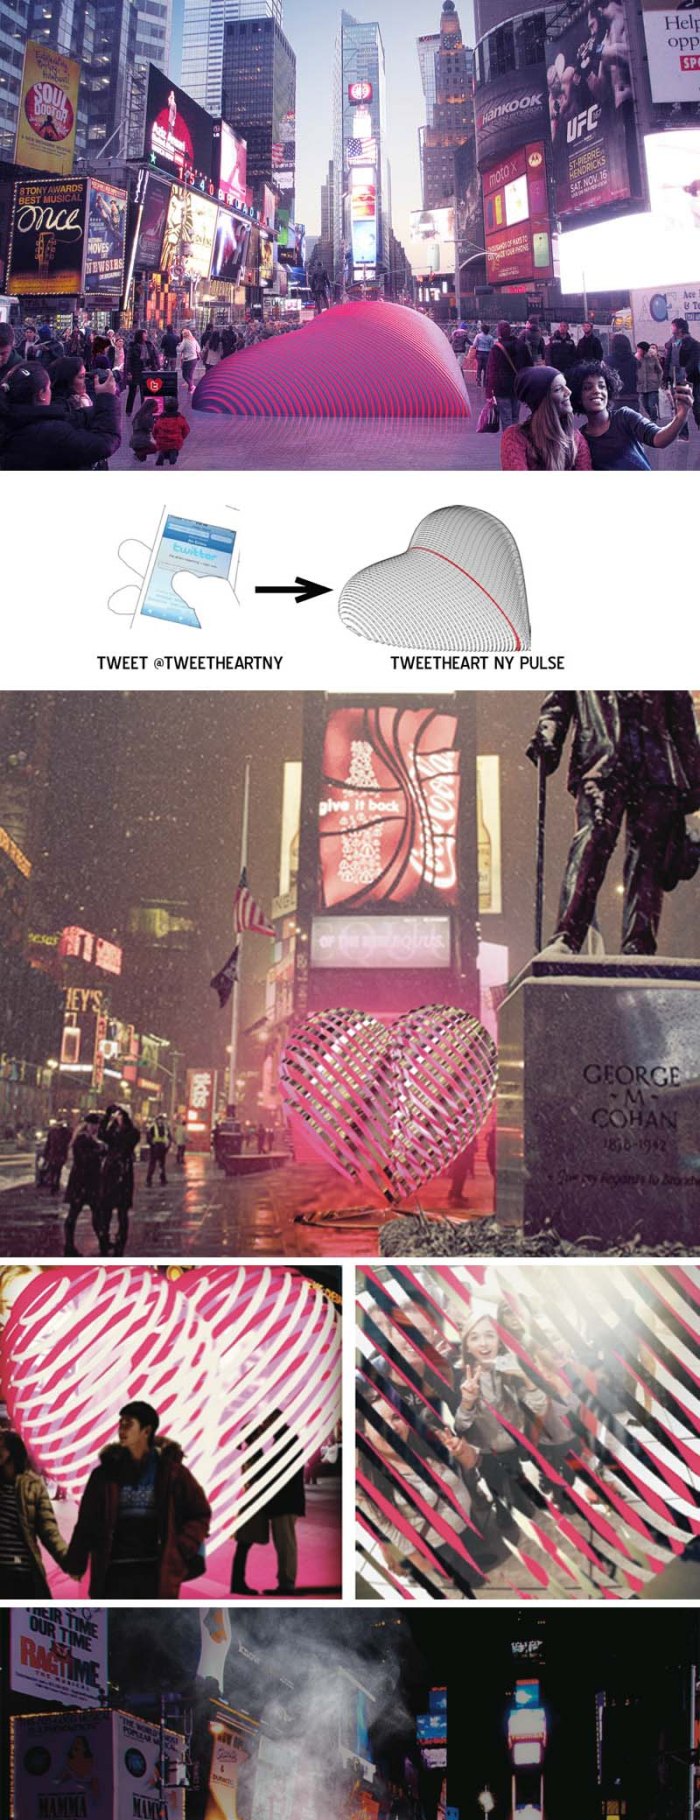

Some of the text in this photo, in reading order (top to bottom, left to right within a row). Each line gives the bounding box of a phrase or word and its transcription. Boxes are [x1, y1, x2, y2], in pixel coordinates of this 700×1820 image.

[33, 82, 68, 110] SOUL
[34, 101, 69, 122] DOCTOR
[566, 103, 599, 143] UFC
[569, 156, 607, 181] HENDRICKS
[600, 169, 608, 180] 16
[18, 193, 83, 205] BEST MUSICAL
[20, 187, 25, 196] 8
[25, 185, 46, 195] TONY
[47, 183, 84, 194] AWARDS
[86, 258, 124, 274] NEWSIES
[319, 798, 400, 816] give it back
[583, 1063, 680, 1088] GEORGE
[592, 1107, 678, 1129] COHAN
[29, 1615, 92, 1653] OUR TIME
[65, 1611, 99, 1640] TIME
[20, 1635, 101, 1689] RAGTIME
[38, 1797, 87, 1817] MAMMA
